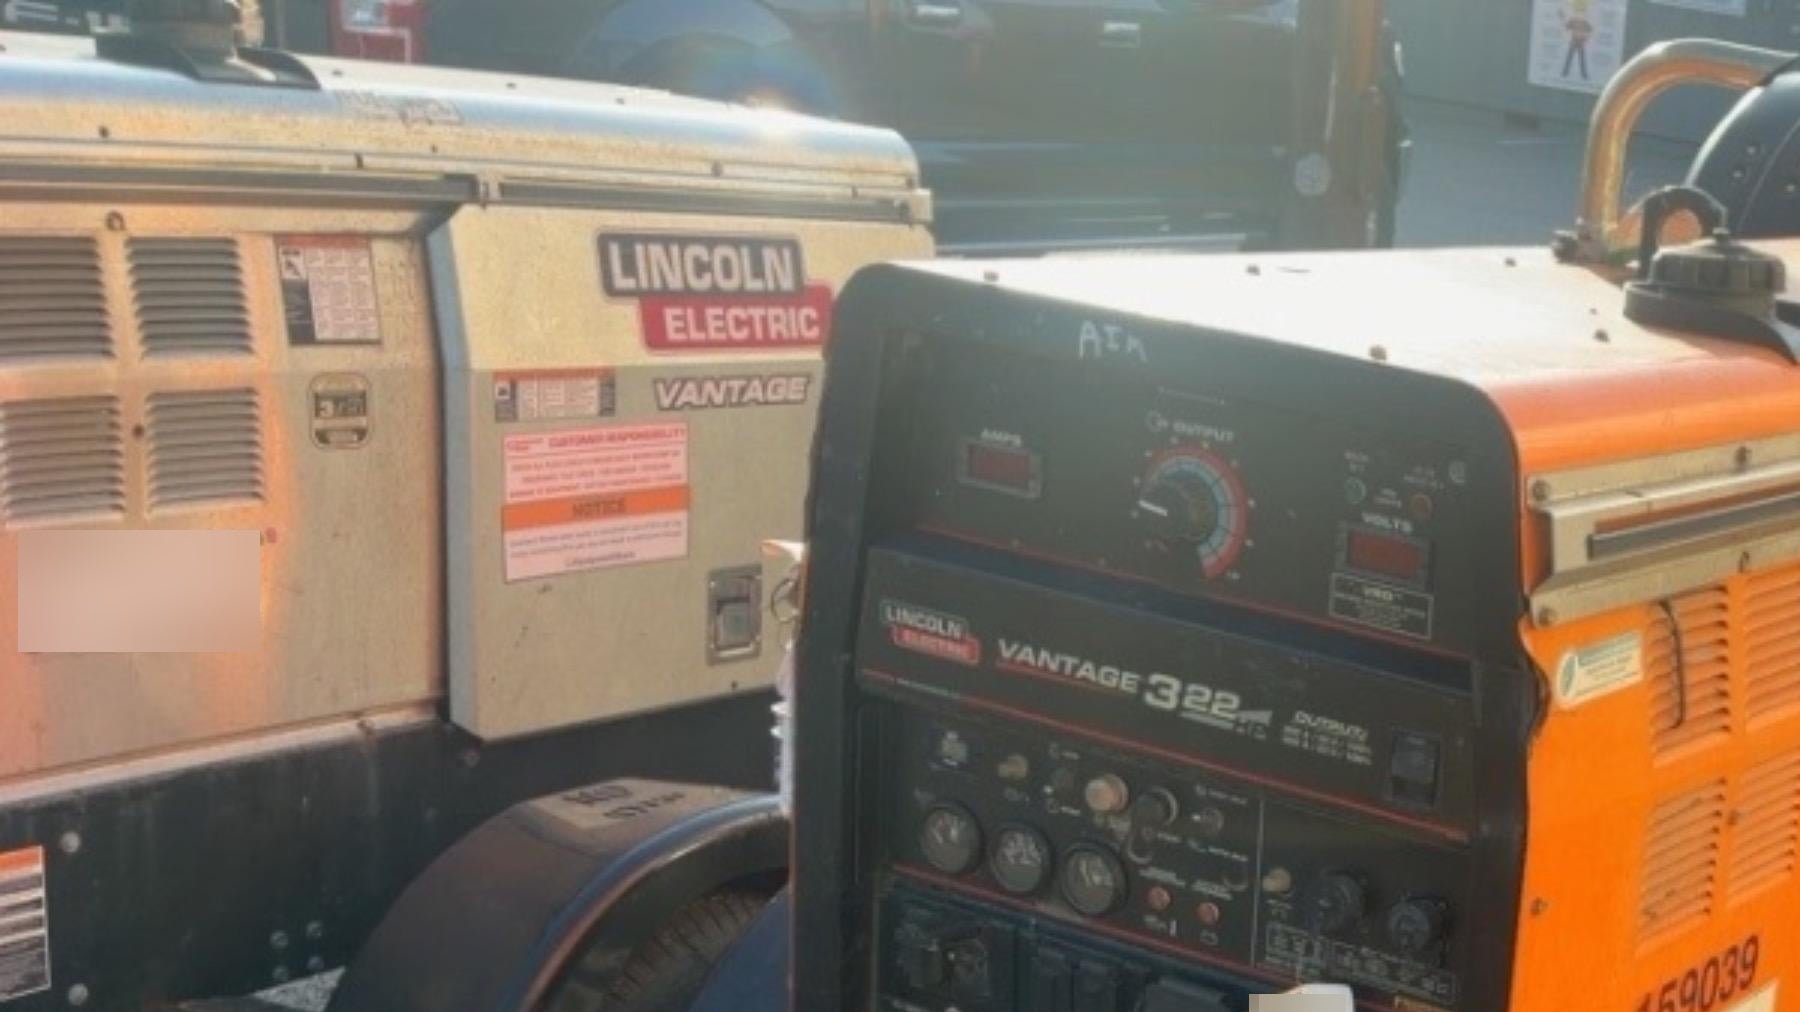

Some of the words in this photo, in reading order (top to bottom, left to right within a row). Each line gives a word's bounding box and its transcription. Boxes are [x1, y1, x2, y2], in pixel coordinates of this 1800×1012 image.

[607, 241, 795, 291] LINCOLN
[664, 306, 820, 341] ELECTRIC
[655, 373, 809, 411] VANTAGE
[886, 606, 961, 639] LINCOLN
[998, 637, 1140, 695] VANTAGE
[1143, 673, 1240, 717] 322
